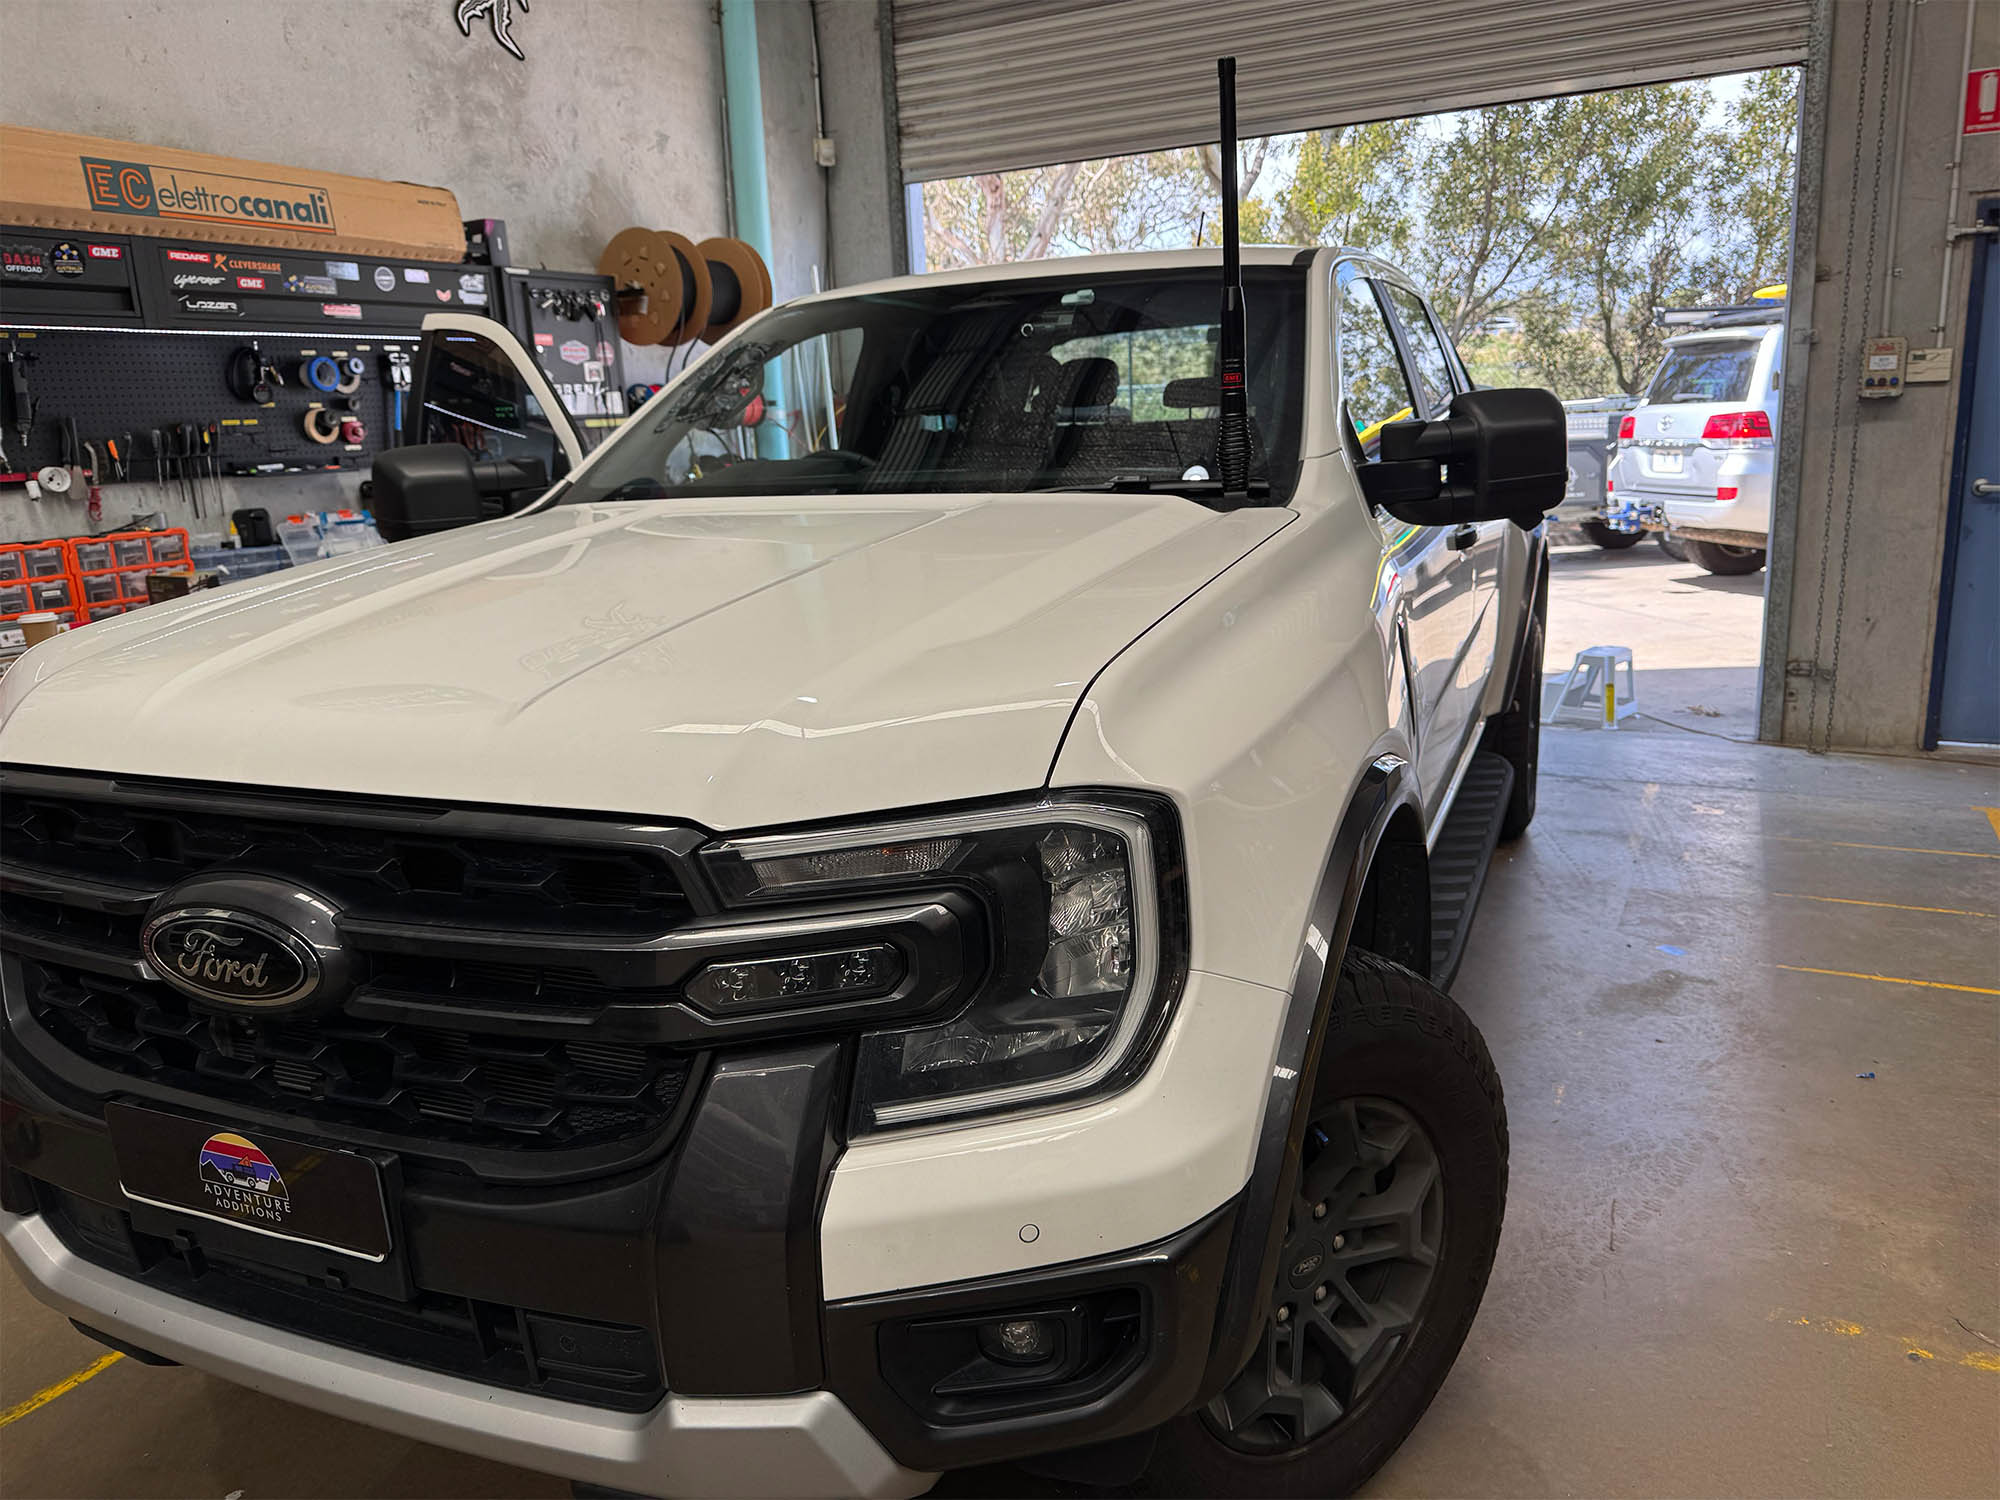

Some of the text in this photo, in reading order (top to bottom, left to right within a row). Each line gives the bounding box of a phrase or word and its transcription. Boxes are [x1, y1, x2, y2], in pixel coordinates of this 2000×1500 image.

[85, 163, 330, 225] EC elettrocanali
[92, 247, 119, 258] GME
[5, 264, 43, 273] OFFROAD
[229, 260, 281, 271] CLEVERSHADE
[239, 278, 263, 288] GME
[177, 928, 269, 988] Ford
[204, 1183, 292, 1213] ADVENTURE
[215, 1198, 282, 1222] ADDITIONS
